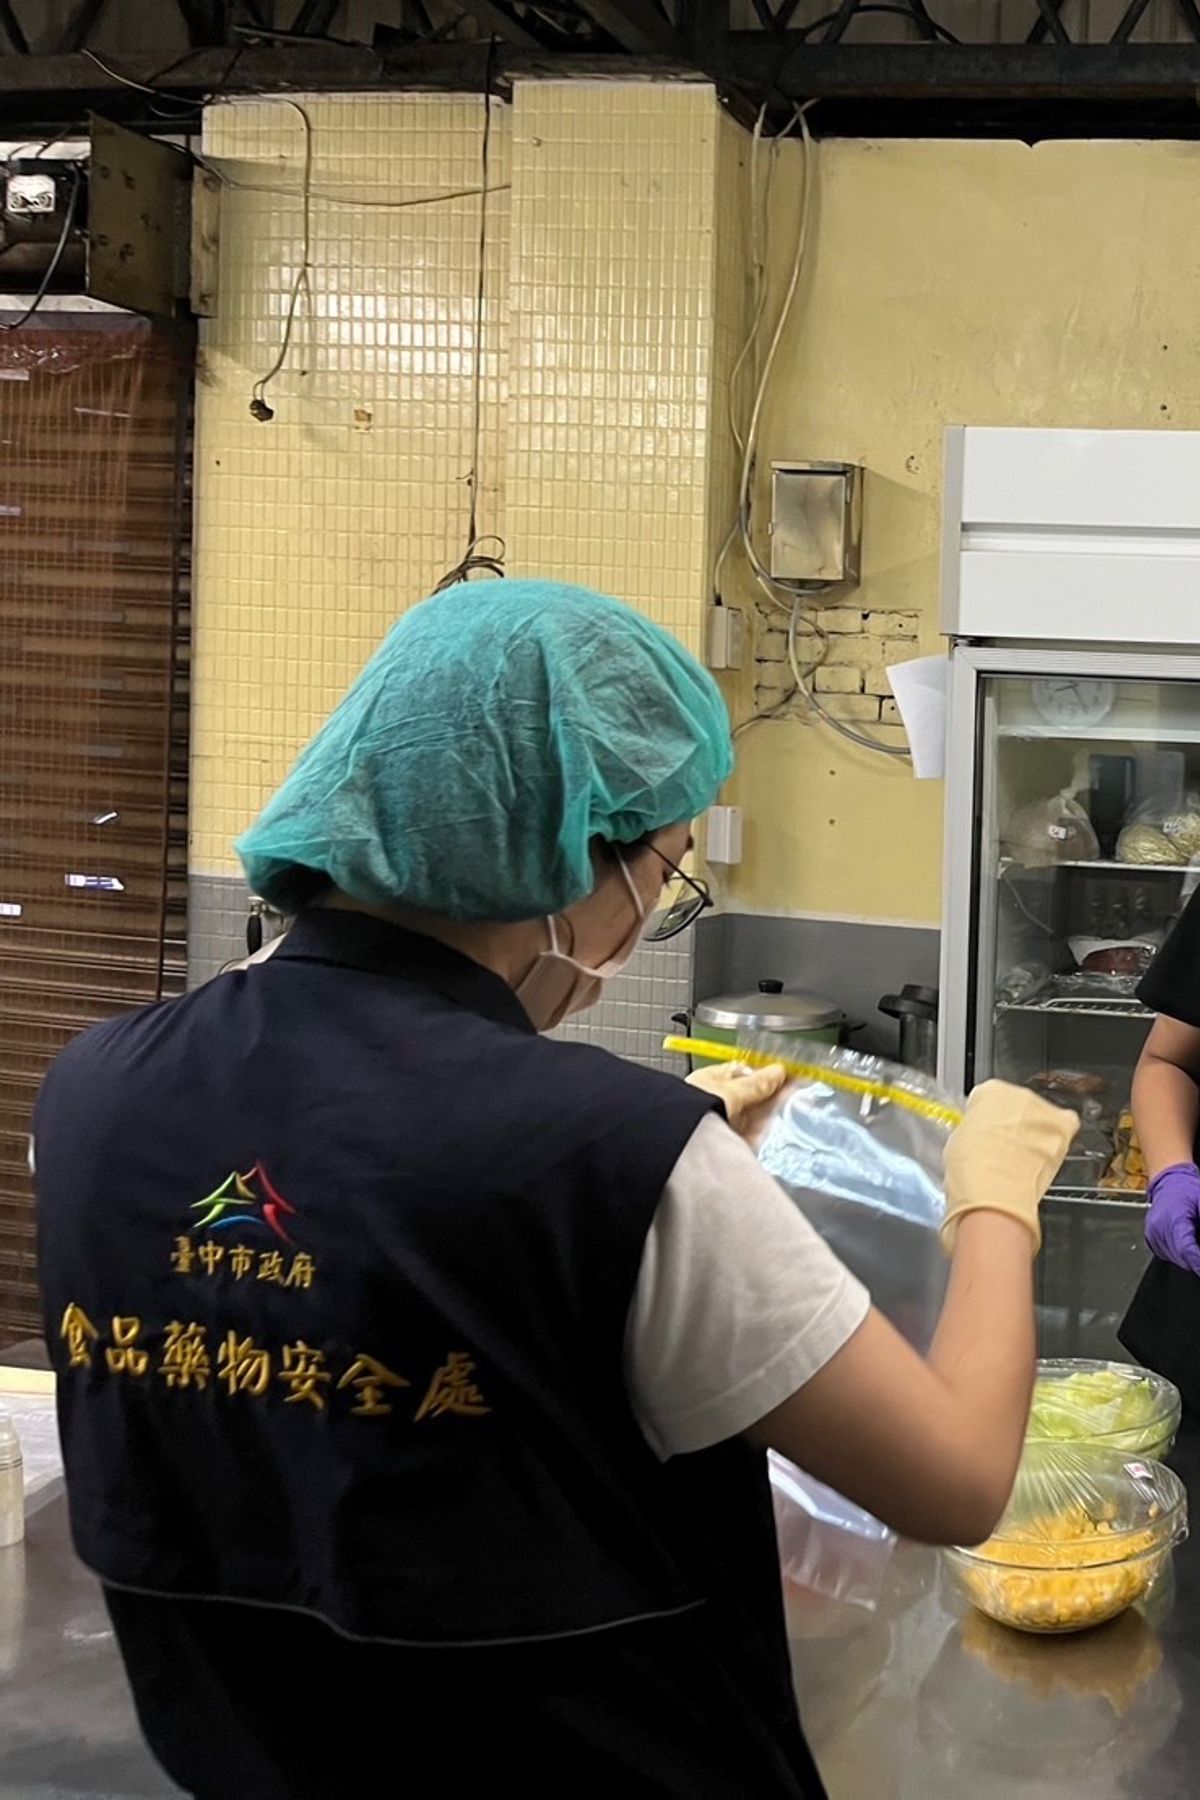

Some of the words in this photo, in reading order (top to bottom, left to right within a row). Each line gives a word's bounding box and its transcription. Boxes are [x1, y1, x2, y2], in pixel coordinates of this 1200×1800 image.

[170, 1236, 316, 1288] 臺中市政府
[60, 1302, 492, 1422] 食品藥物安全處
